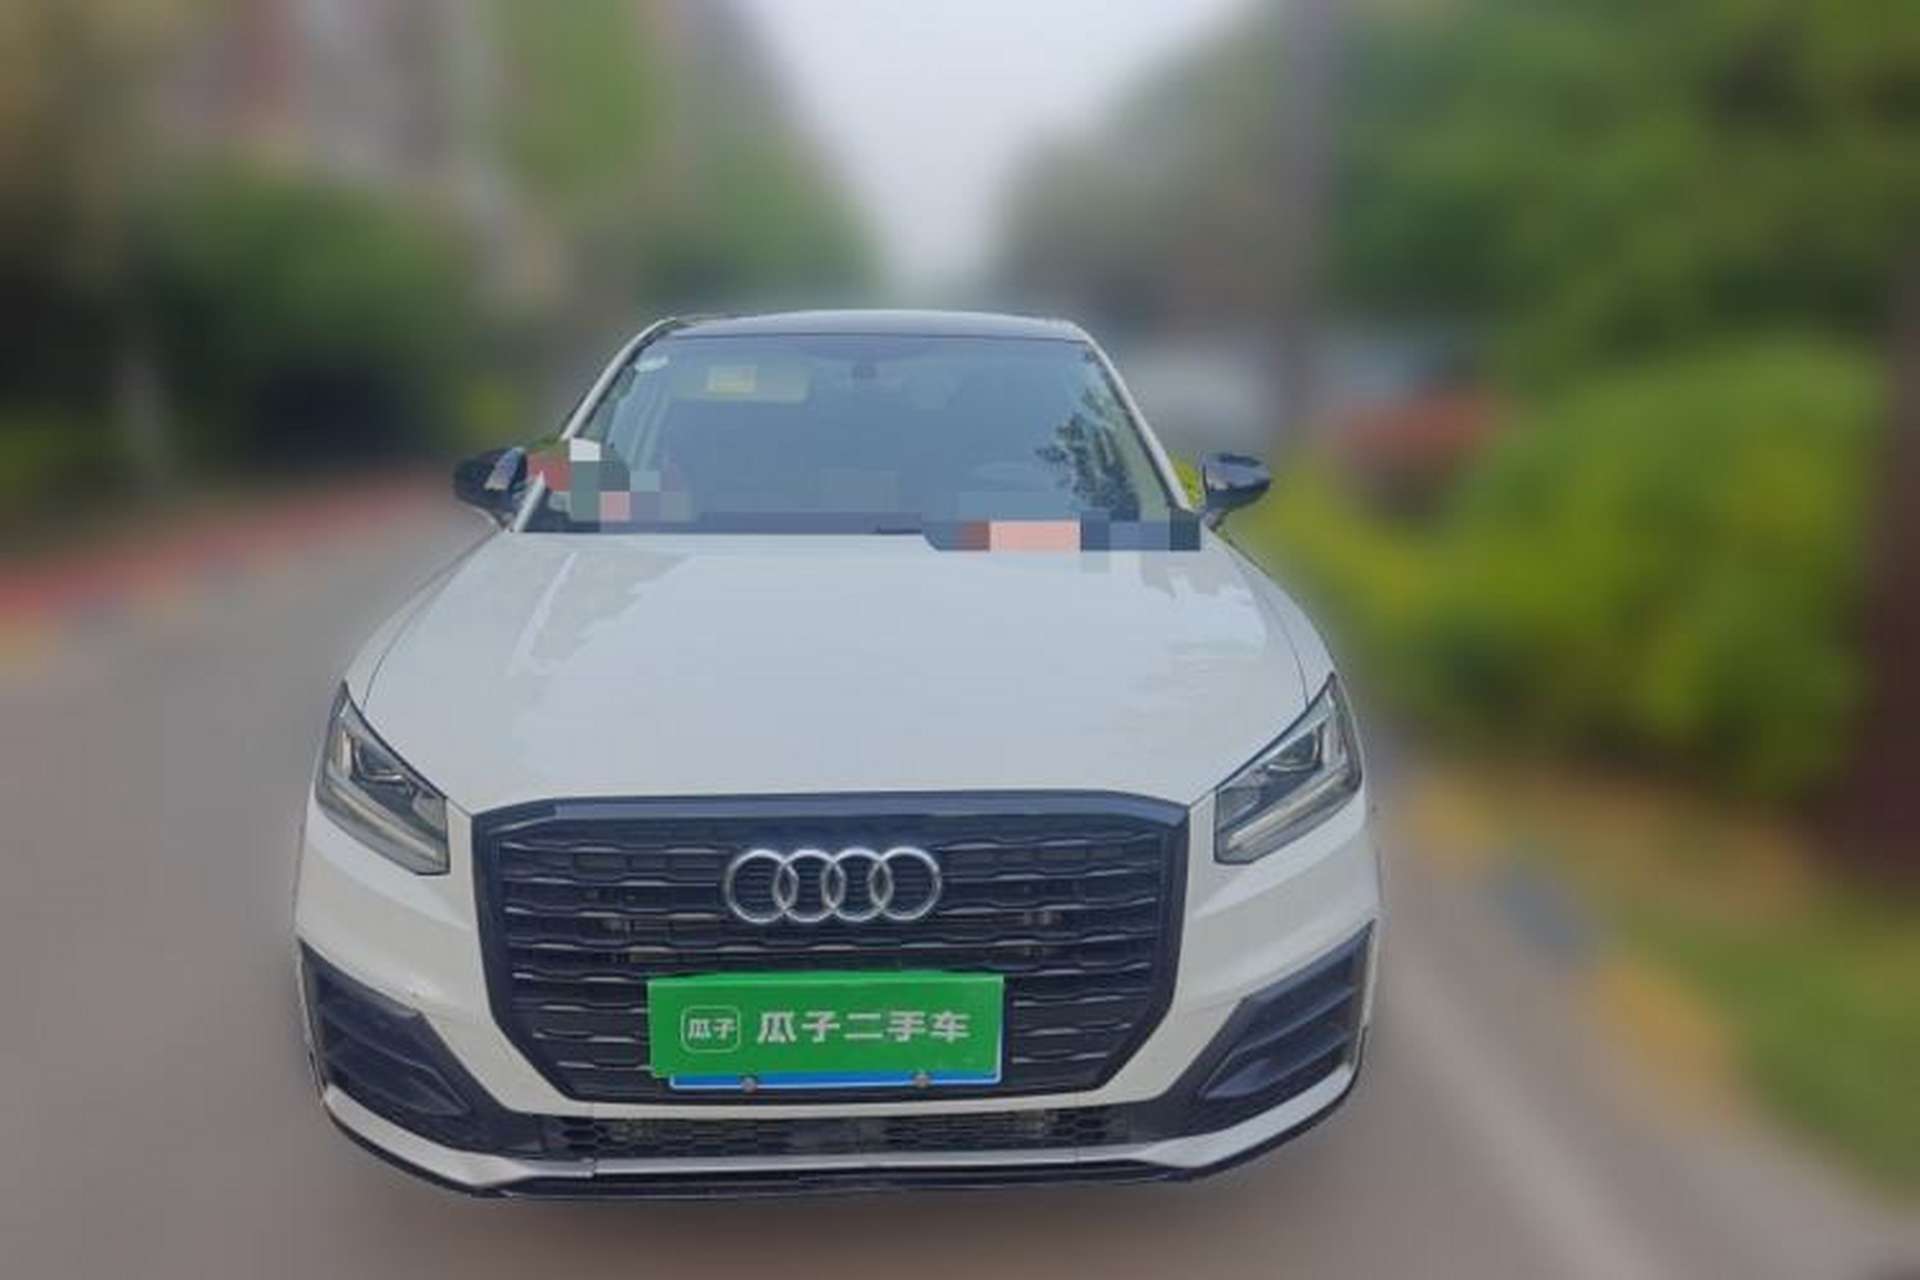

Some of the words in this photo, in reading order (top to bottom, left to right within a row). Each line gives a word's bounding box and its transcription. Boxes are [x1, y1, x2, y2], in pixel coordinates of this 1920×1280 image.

[687, 1017, 737, 1040] 瓜子
[757, 1010, 971, 1044] 瓜子二手车
